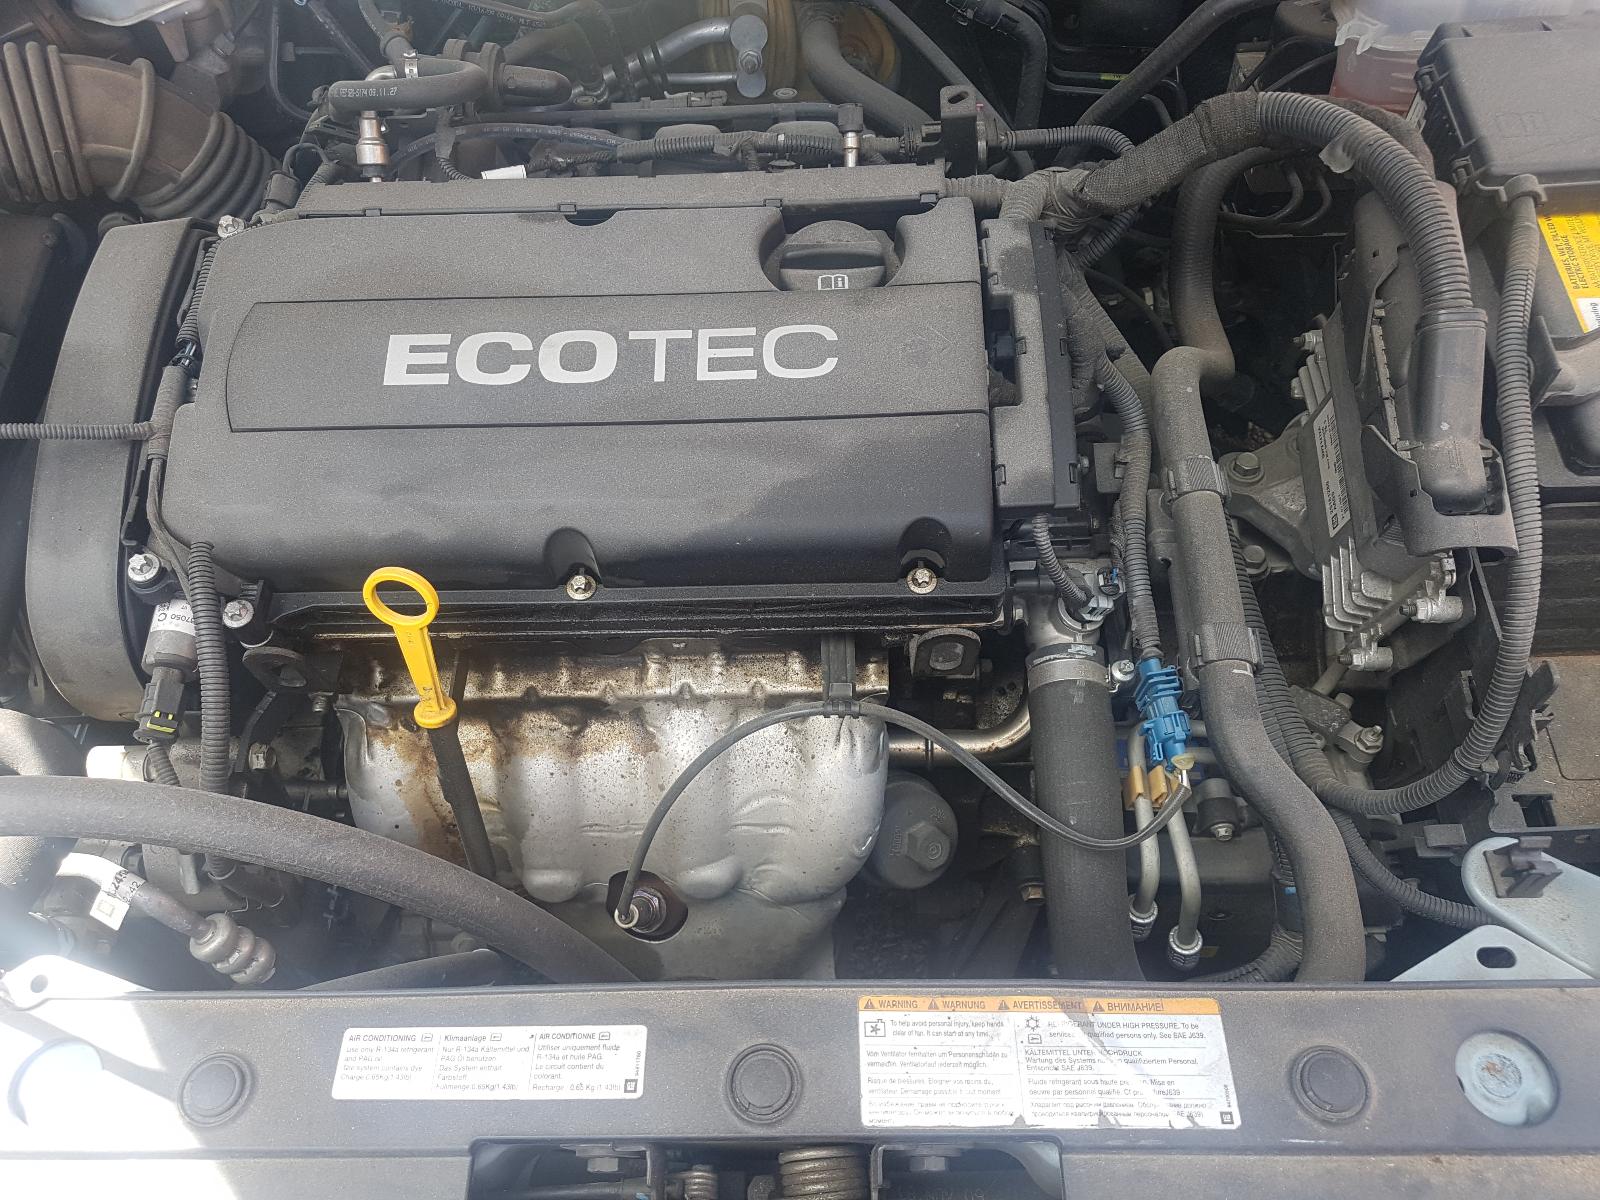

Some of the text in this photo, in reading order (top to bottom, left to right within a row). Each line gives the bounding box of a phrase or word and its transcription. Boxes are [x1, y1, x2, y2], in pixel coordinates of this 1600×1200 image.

[383, 325, 839, 386] ECOTEC
[878, 1000, 1082, 1010] WARNING WARNUNG AVERTISSEMENT
[1108, 1002, 1164, 1012] ВНИМАНИЕ!
[898, 1020, 910, 1028] help
[928, 1020, 952, 1030] personal
[1097, 1022, 1121, 1030] UNDER
[1122, 1022, 1140, 1030] HIGH
[1182, 1022, 1190, 1030] To
[1191, 1022, 1199, 1030] be
[348, 1034, 416, 1042] AIR CONDITIONING
[444, 1034, 487, 1043] Klimaanlage
[538, 1033, 550, 1041] AIR
[944, 1030, 956, 1038] start
[958, 1030, 964, 1038] at
[964, 1031, 975, 1039] any
[1115, 1033, 1142, 1042] persons
[1026, 1056, 1054, 1066] Wartung
[1055, 1057, 1066, 1065] des
[1068, 1057, 1096, 1066] Systems
[1061, 1064, 1075, 1072] SAE
[1168, 1080, 1175, 1088] en
